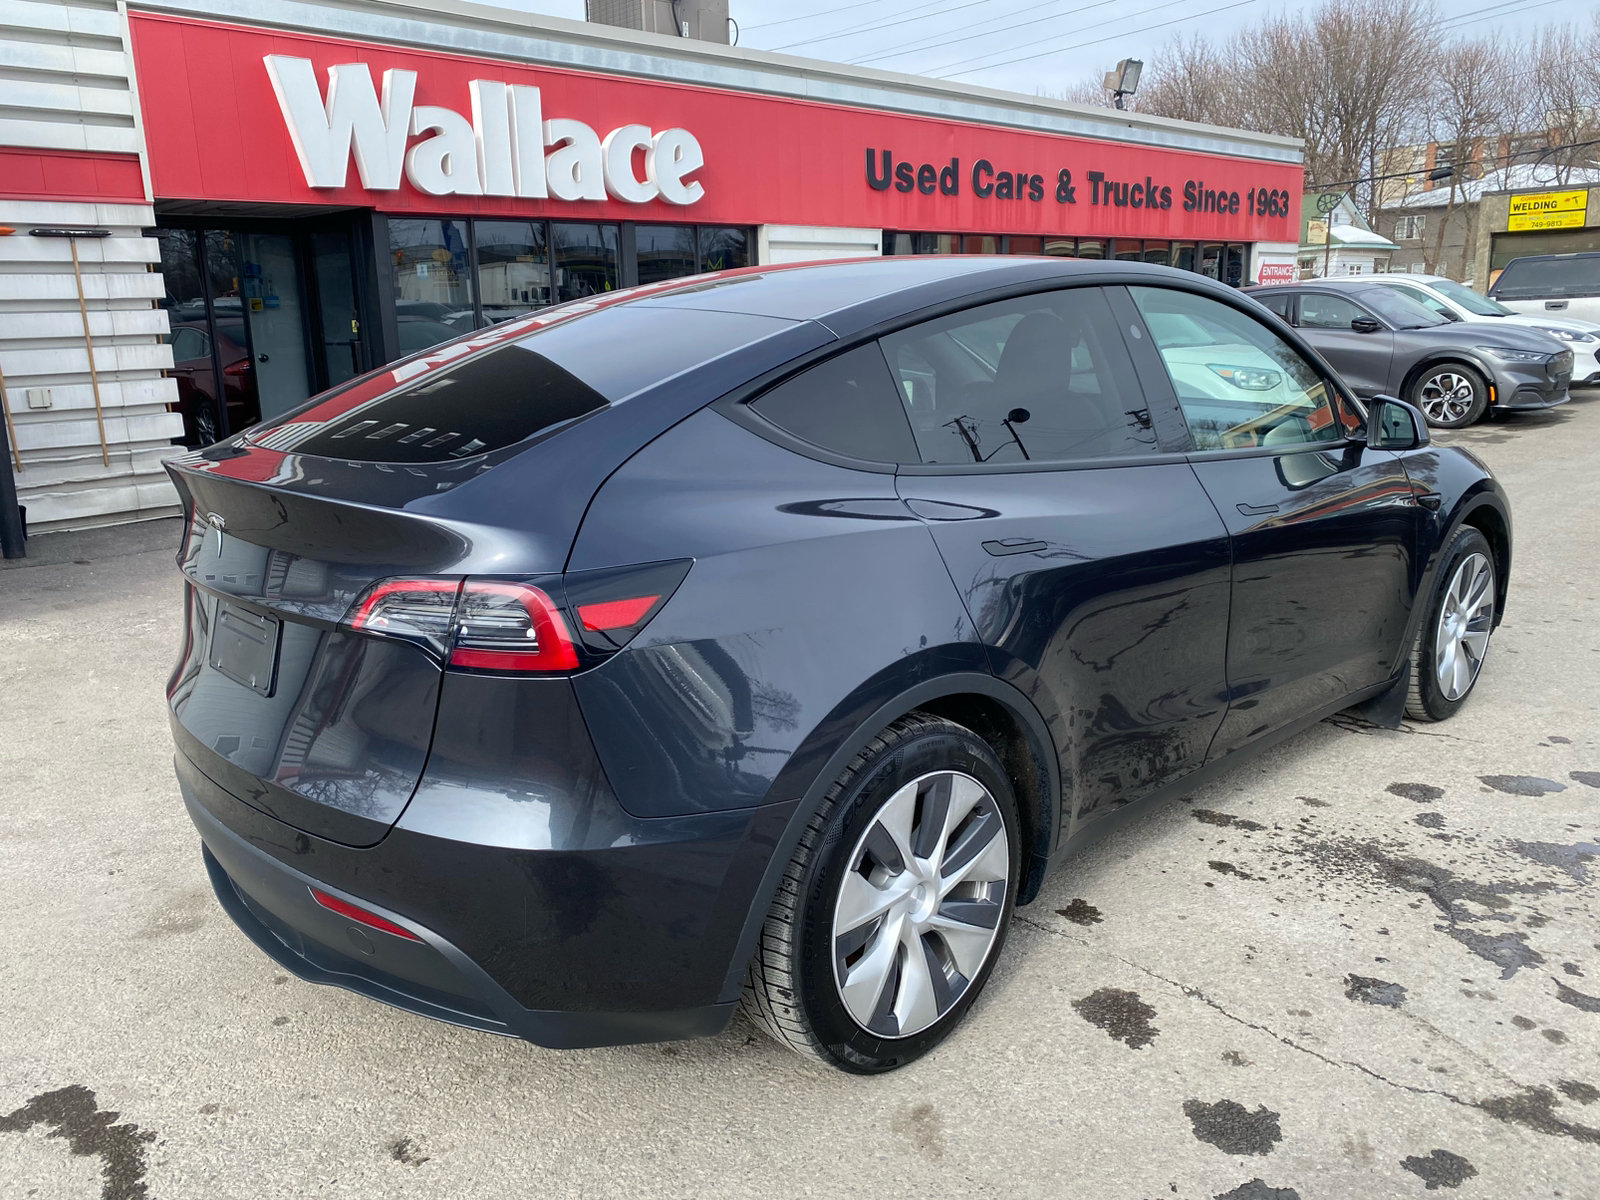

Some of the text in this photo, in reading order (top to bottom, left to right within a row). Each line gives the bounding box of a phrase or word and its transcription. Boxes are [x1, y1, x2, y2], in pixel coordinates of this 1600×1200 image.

[263, 54, 705, 205] Wallace
[865, 147, 1290, 218] Used Cars & Trucks Since 1963
[1513, 201, 1557, 211] WELDING
[1531, 220, 1562, 228] 749-9813
[1262, 266, 1293, 276] ENTRANCE
[812, 866, 828, 901] UHP
